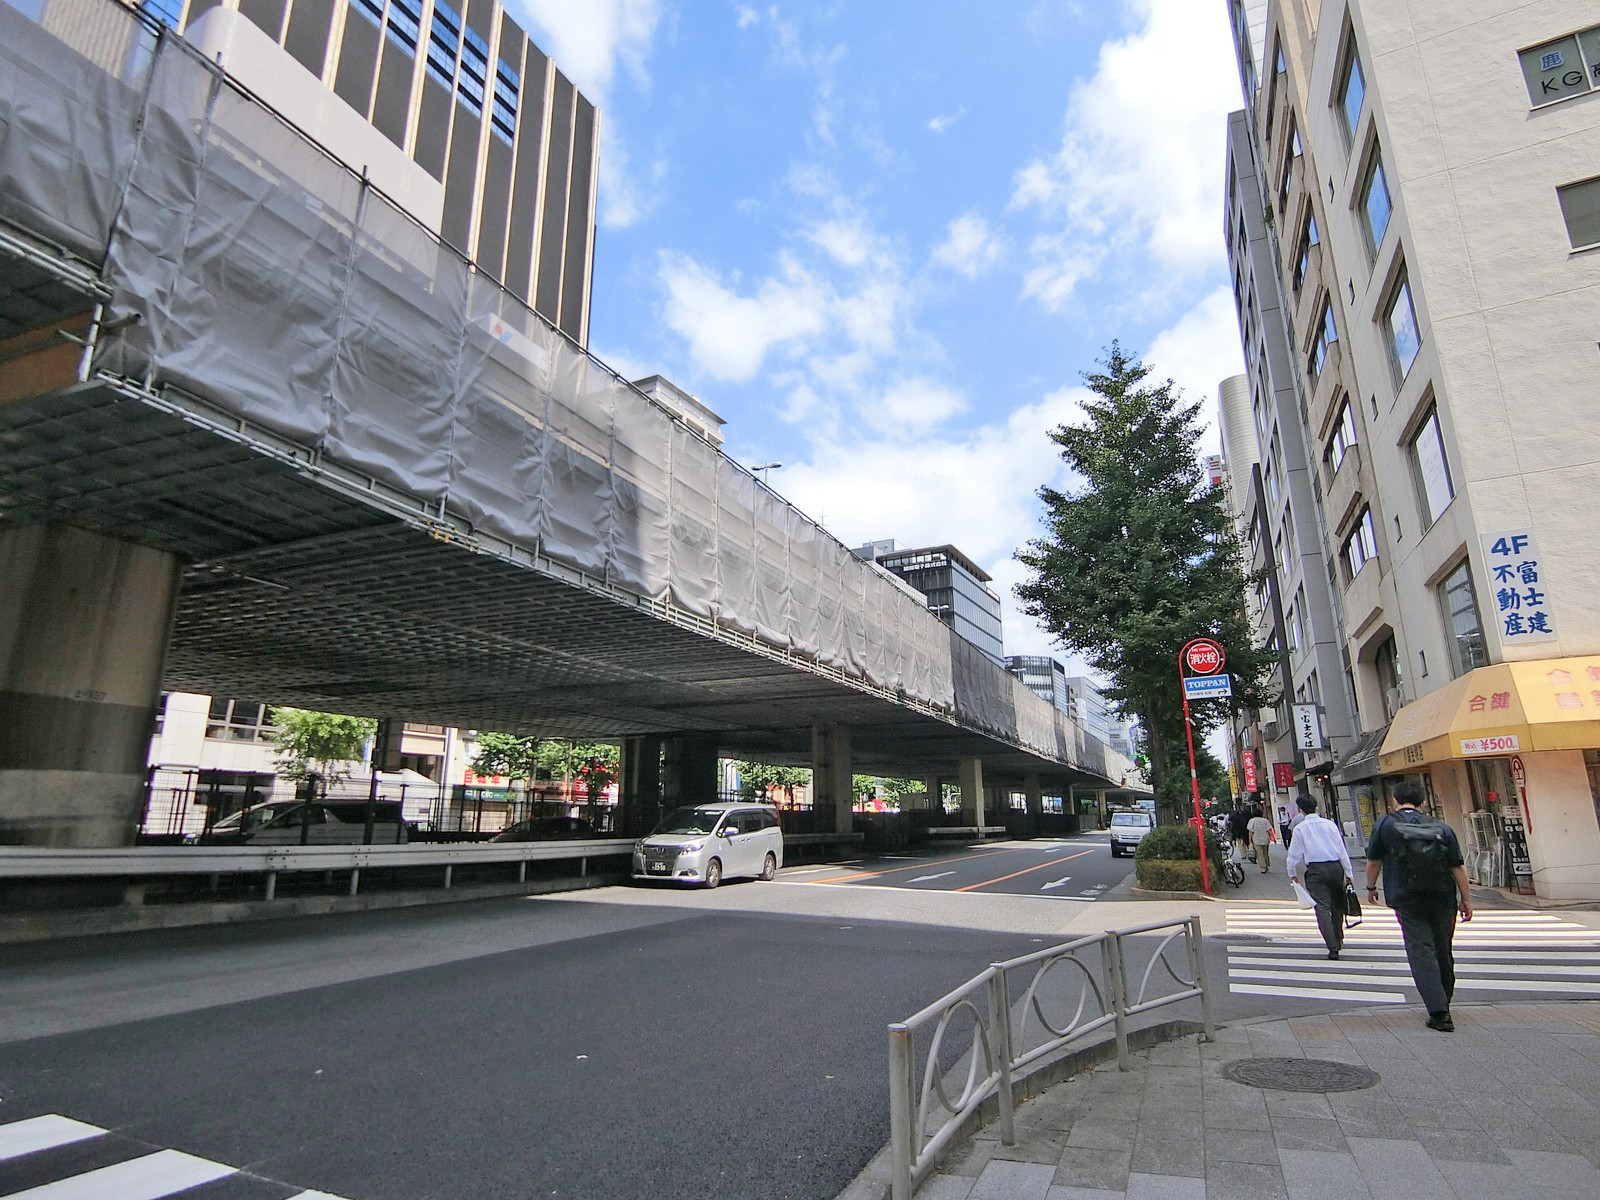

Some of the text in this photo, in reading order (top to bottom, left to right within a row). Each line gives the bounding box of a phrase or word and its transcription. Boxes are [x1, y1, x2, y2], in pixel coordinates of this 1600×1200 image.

[1541, 51, 1562, 69] 鹿
[1490, 534, 1529, 556] 4F
[1189, 651, 1217, 665] 消火栓
[1187, 678, 1227, 689] TOPPAN
[1469, 691, 1511, 713] 合鍵
[1480, 737, 1514, 751] ¥500
